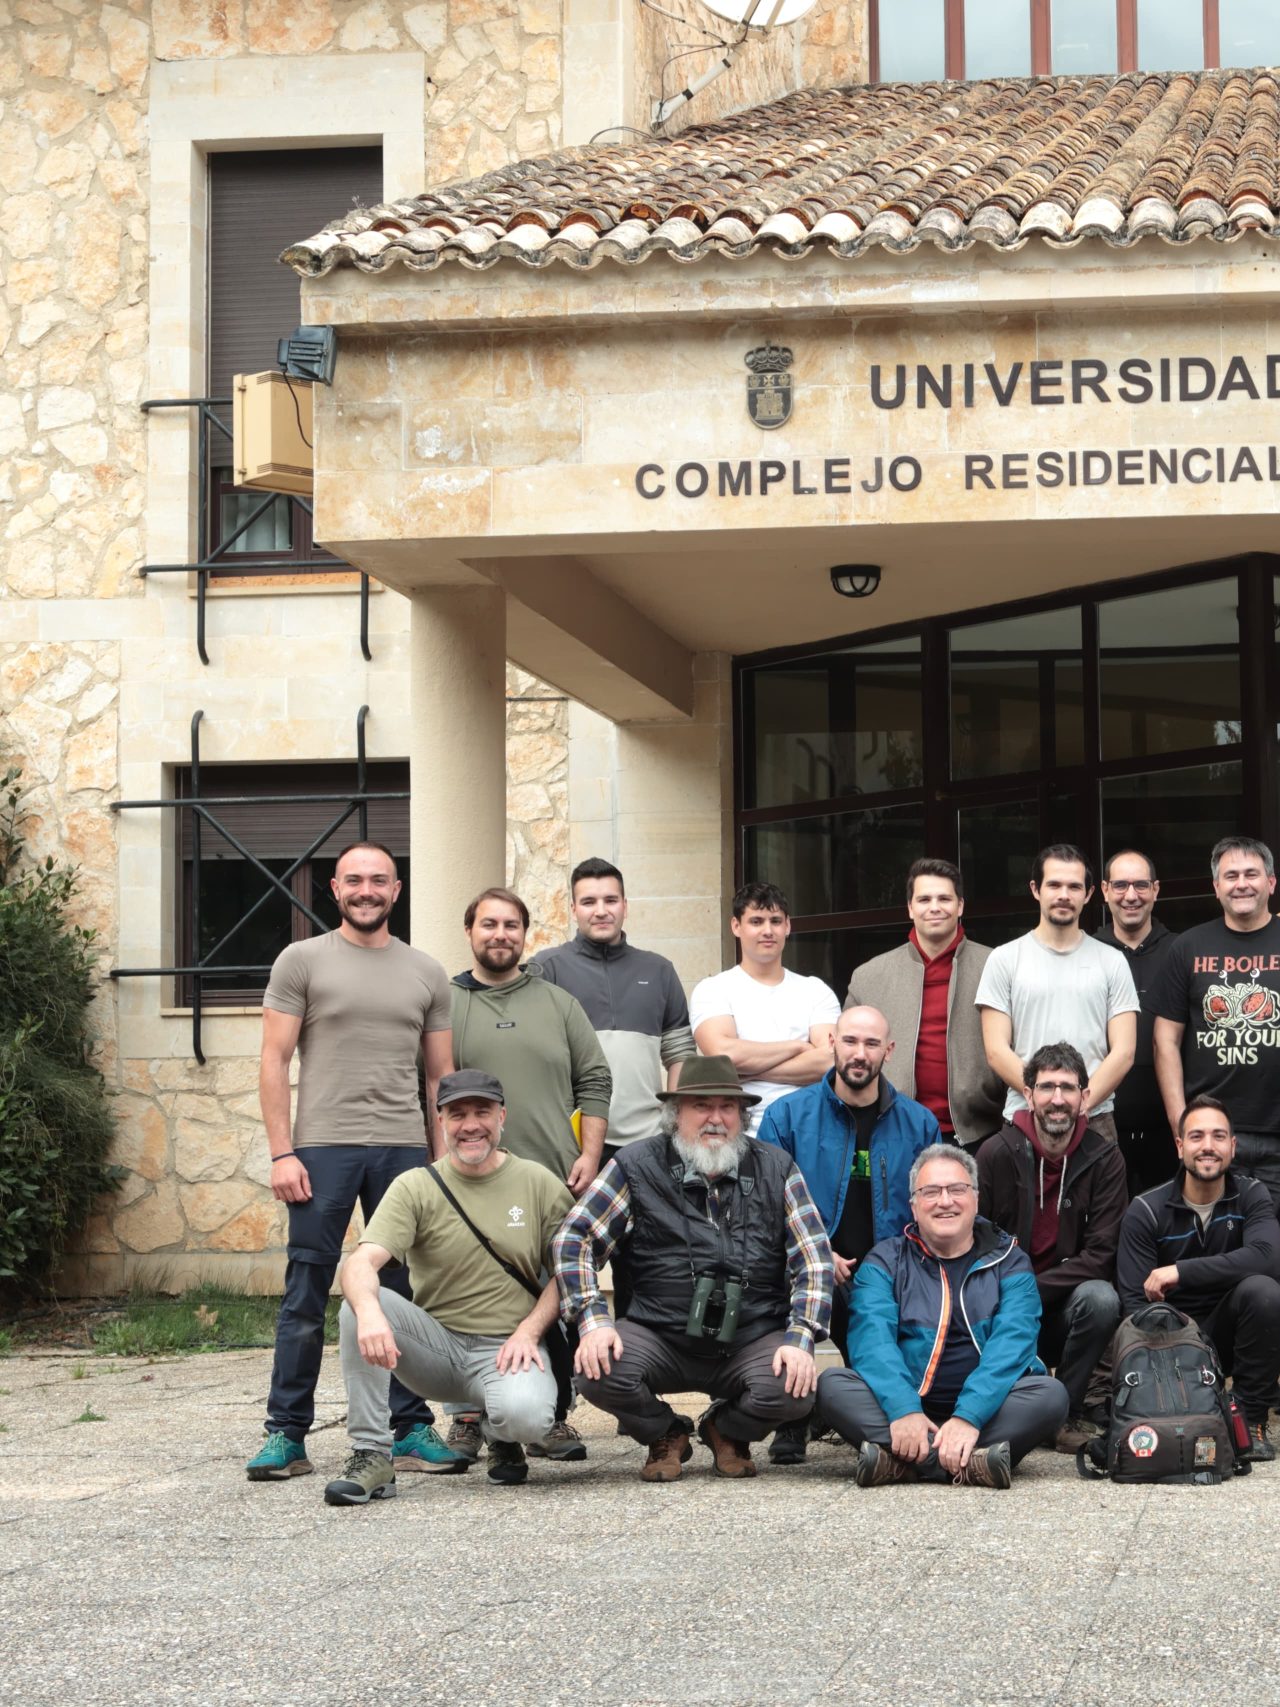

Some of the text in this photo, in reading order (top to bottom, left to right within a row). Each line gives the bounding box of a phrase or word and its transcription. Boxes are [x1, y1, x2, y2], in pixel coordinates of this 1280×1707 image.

[635, 456, 922, 499] COMPLEJO
[1193, 956, 1219, 974] HE
[1196, 1029, 1228, 1049] FOR
[1216, 1046, 1259, 1066] SINS
